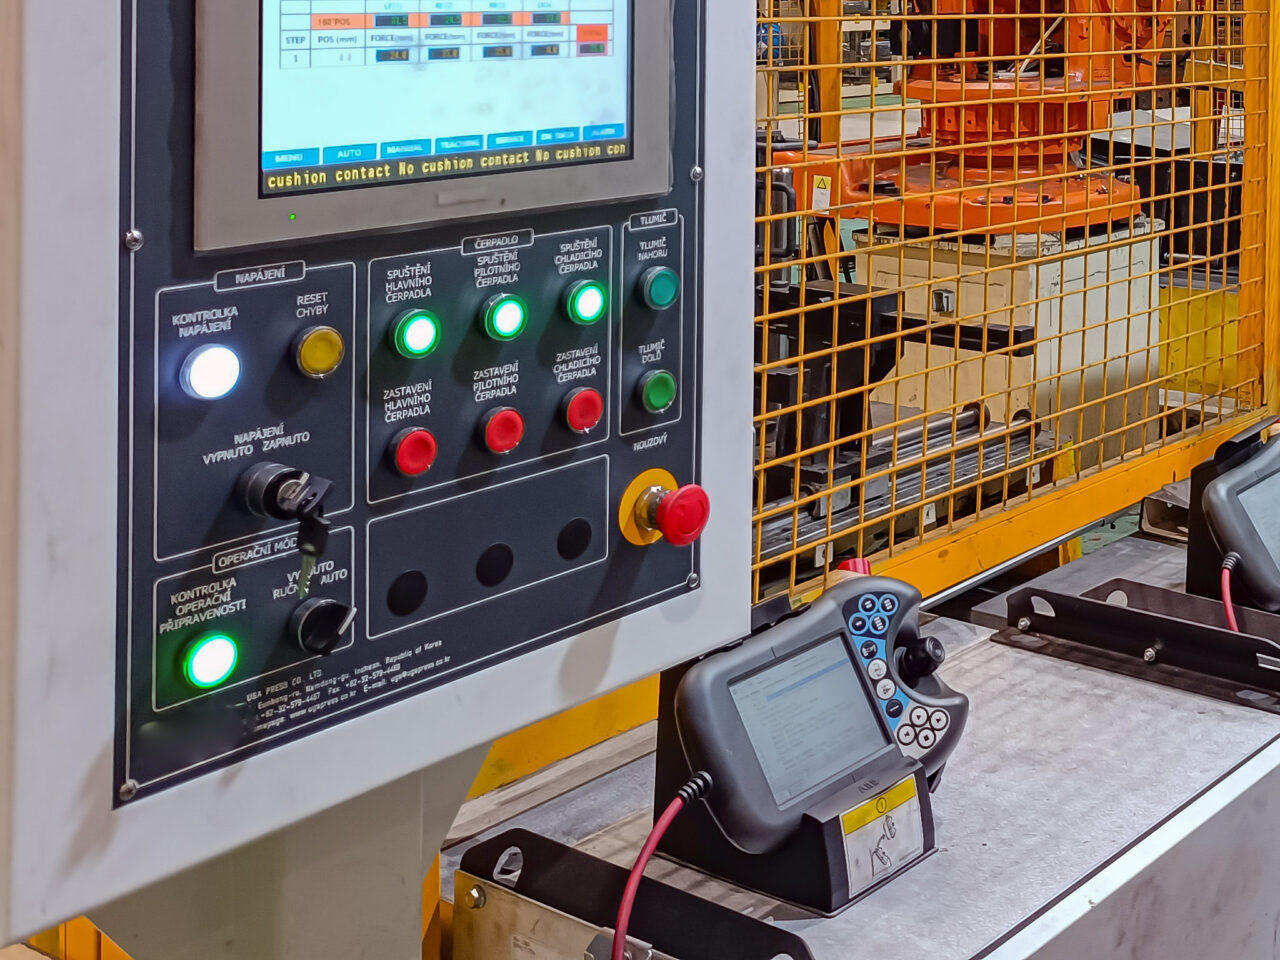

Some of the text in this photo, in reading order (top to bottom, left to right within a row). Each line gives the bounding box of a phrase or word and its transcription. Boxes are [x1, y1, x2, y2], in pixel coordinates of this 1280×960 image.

[286, 36, 306, 44] STEP
[337, 149, 361, 158] AUTO
[267, 143, 626, 188] cushion contact No cushion contact No cushion con
[640, 212, 667, 225] TLUMIČ
[474, 235, 519, 250] ČERPADLO
[560, 236, 598, 253] SPUŠTĚNÍ
[639, 236, 667, 250] TLUMIČ
[477, 248, 519, 266] SPUŠTĚNÍ
[235, 265, 286, 284] NAPÁJENÍ
[386, 261, 431, 280] SPUŠTĚNÍ
[474, 261, 520, 278] PILOTNÍHO
[558, 260, 598, 274] ČERPADLA
[385, 275, 433, 293] HLAVNÍHO
[475, 273, 519, 289] ČERPADLA
[297, 291, 328, 306] RESET
[385, 287, 432, 303] ČERPADLA
[172, 306, 239, 326] KONTROLKA
[296, 304, 329, 318] CHYBY
[178, 317, 232, 338] NAPÁJENÍ
[556, 342, 599, 362] ZASTAVENÍ
[638, 338, 666, 354] TLUMIČ
[473, 359, 519, 380] ZASTAVENÍ
[557, 367, 597, 385] ČERPADLA
[383, 378, 432, 400] ZASTAVENÍ
[473, 373, 519, 392] PILOTNÍHO
[384, 393, 431, 412] HLAVNÍHO
[474, 385, 517, 402] ČERPADLA
[384, 404, 431, 423] ČERPADLA
[234, 422, 284, 444] NAPÁJENÍ
[202, 432, 311, 465] VYPNUTO ZAPNUTO
[218, 545, 272, 568] OPERAČNÍ
[287, 560, 335, 582] VYUTO
[320, 568, 348, 585] AUTO
[170, 577, 237, 606] KONTROLKA
[175, 588, 232, 616] OPERAČNÍ
[159, 598, 247, 634] PŘIPRAVENOSTI
